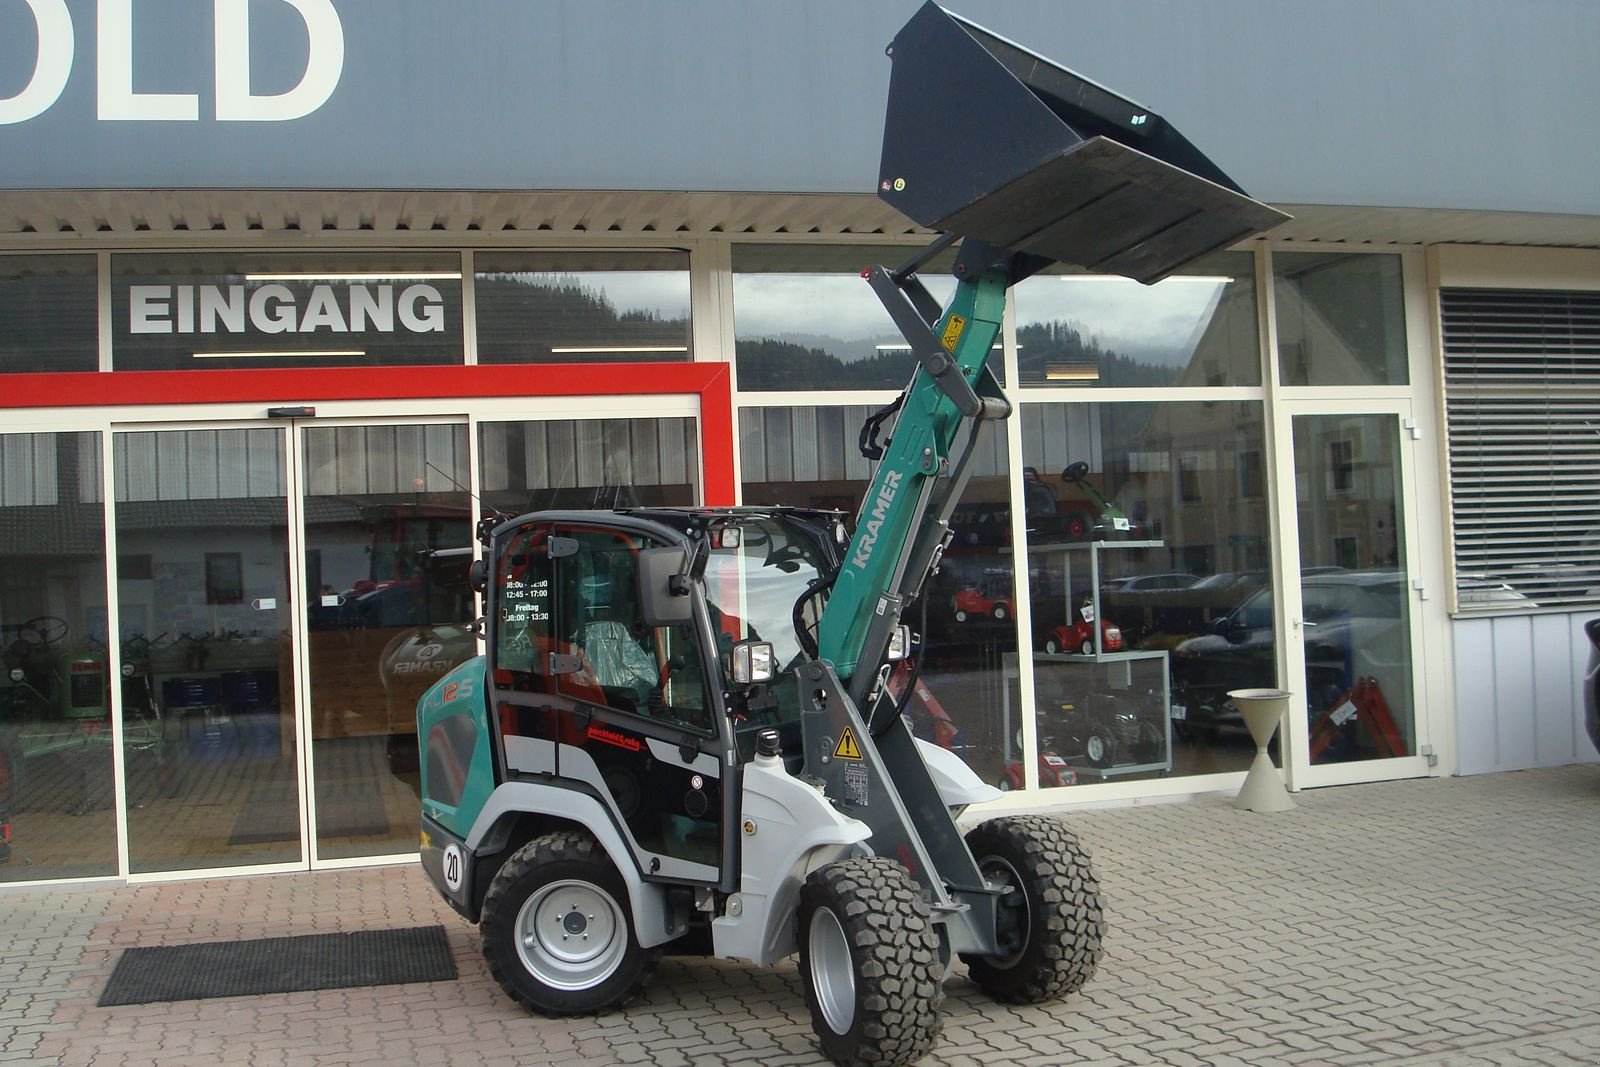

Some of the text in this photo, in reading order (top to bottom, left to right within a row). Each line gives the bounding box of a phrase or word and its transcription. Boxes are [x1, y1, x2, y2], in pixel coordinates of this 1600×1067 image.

[129, 284, 445, 334] EINGANG
[852, 470, 903, 570] KRAMER
[506, 591, 524, 599] 12:45
[530, 590, 548, 598] 17:00
[515, 604, 539, 612] Freitag
[531, 612, 549, 621] 13:30
[447, 852, 458, 883] 20
